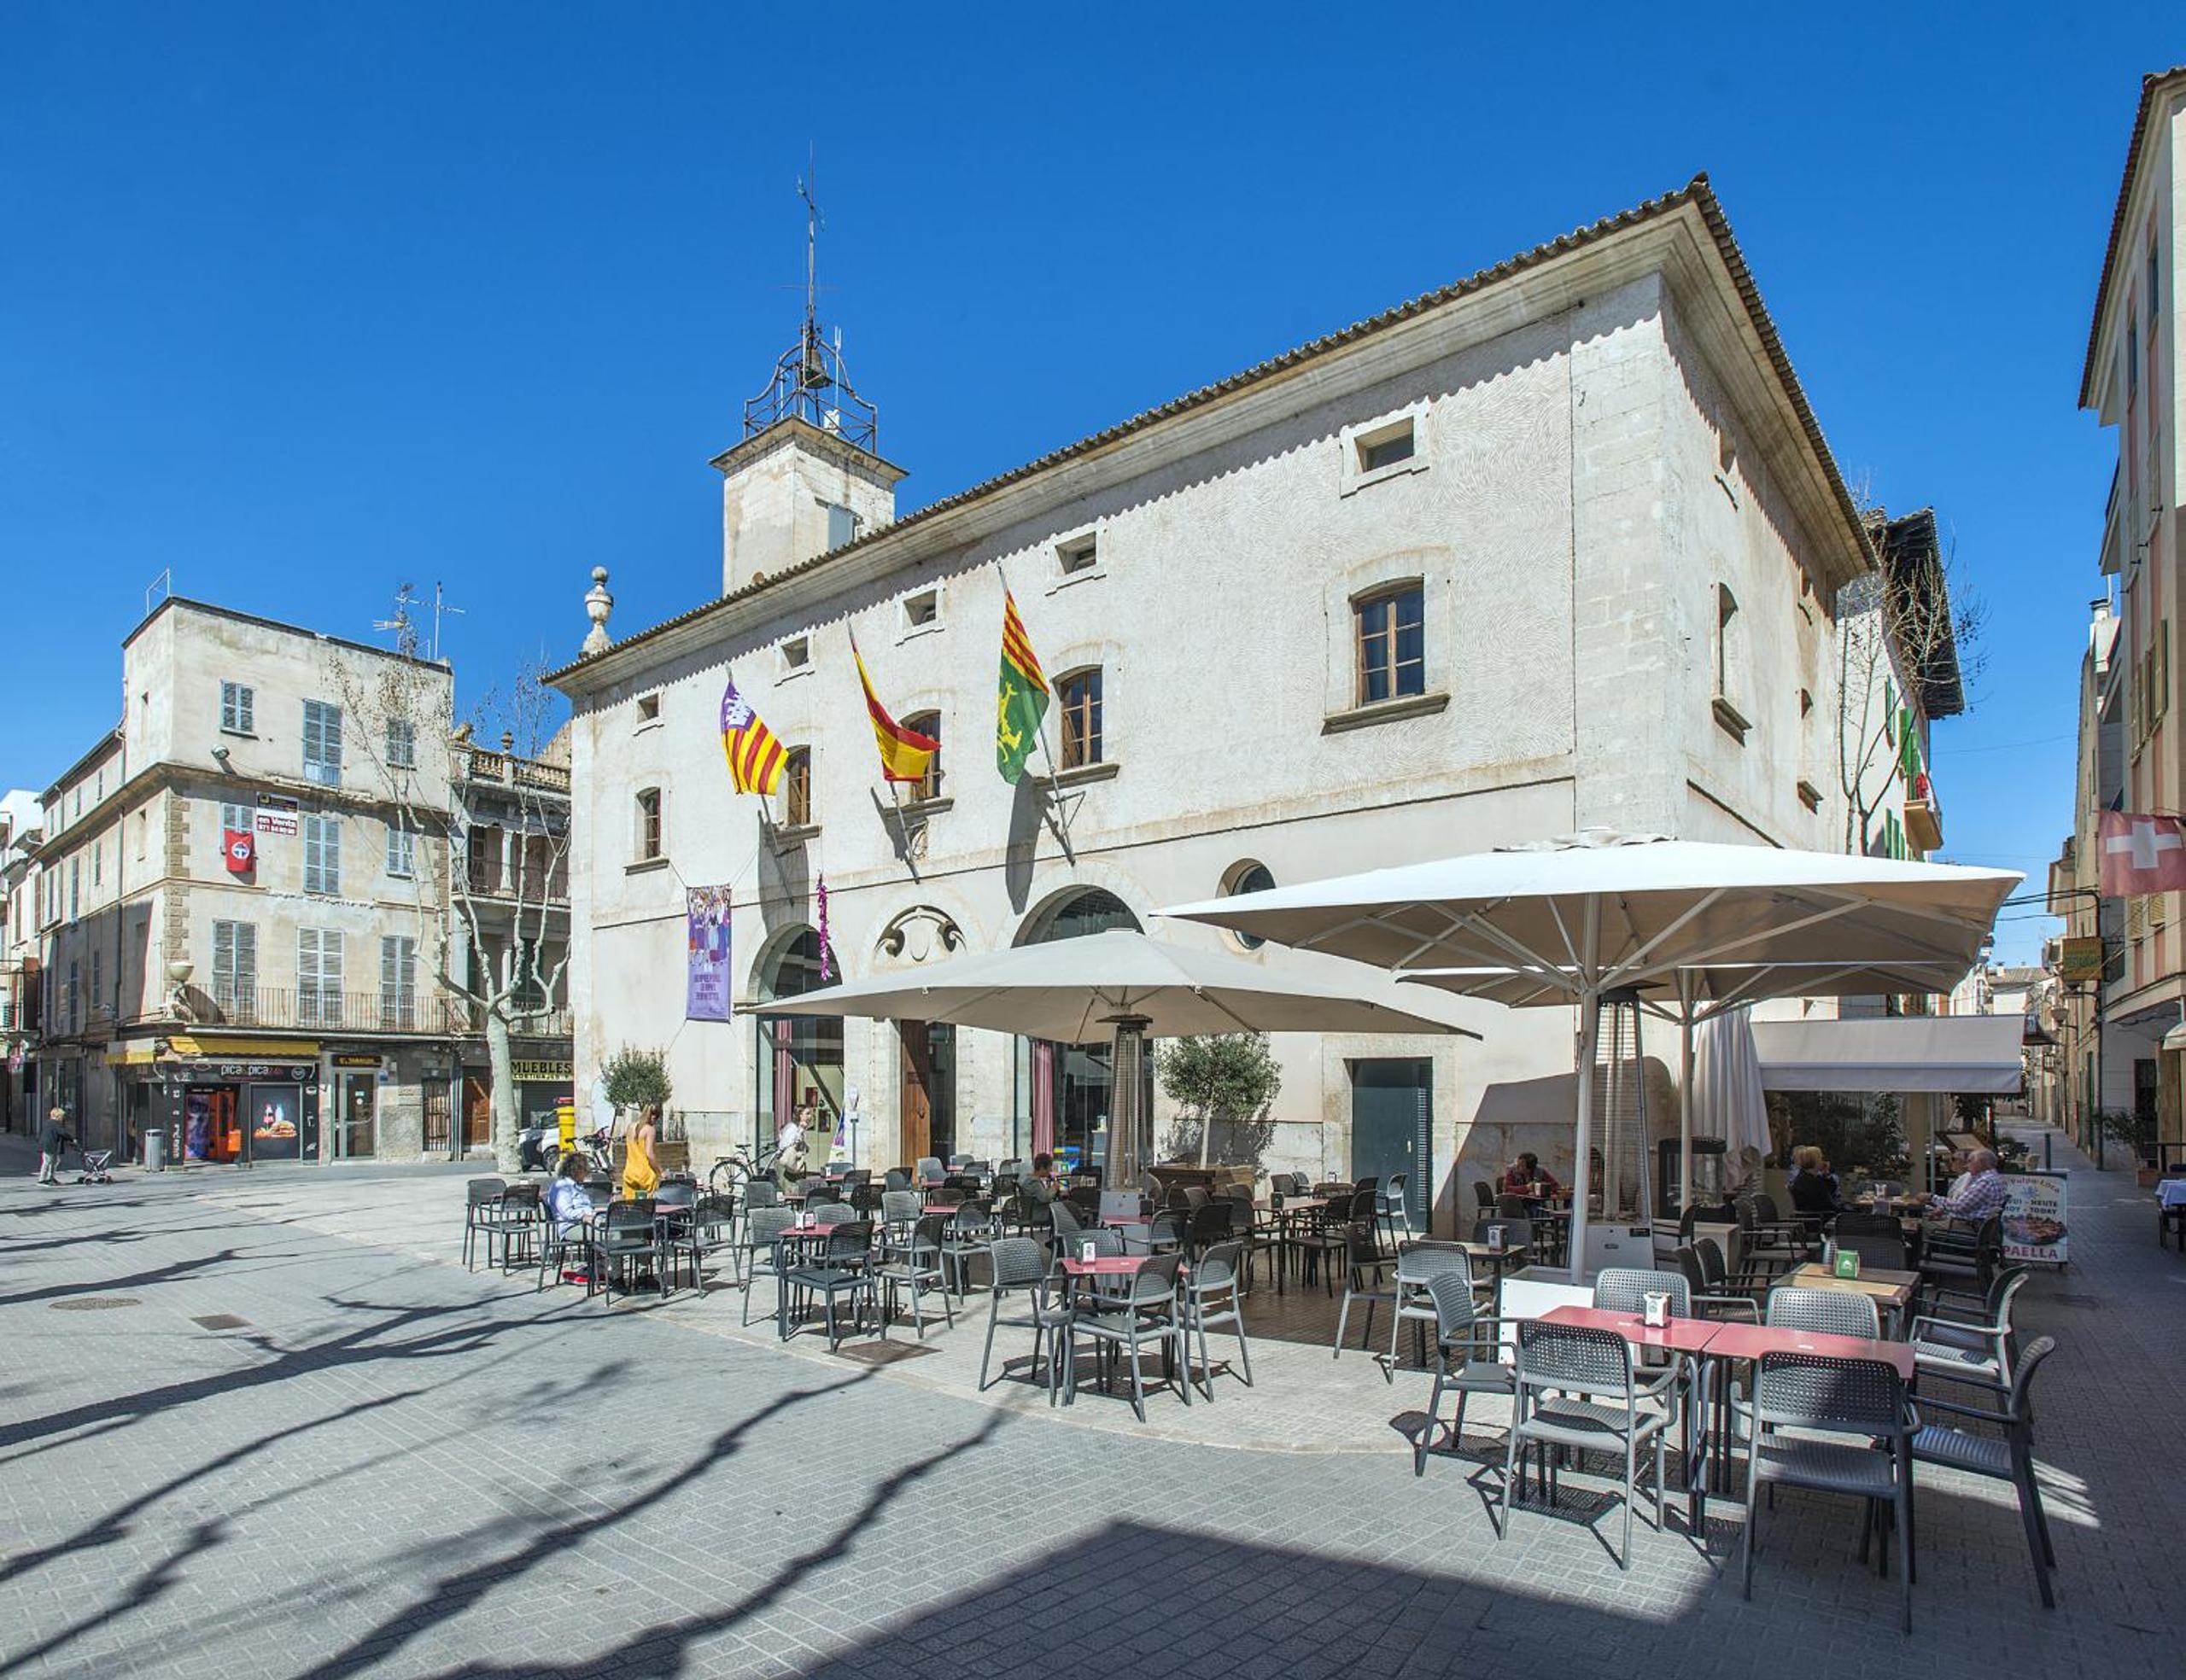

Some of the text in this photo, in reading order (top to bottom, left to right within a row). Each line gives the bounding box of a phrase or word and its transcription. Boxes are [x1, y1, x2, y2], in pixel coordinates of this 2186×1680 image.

[221, 1065, 242, 1076] pica
[248, 1065, 268, 1076] pica
[511, 1061, 572, 1073] MUEBLES
[2031, 1199, 2057, 1207] HEUTE
[2030, 1206, 2057, 1215] TODAY
[2002, 1245, 2059, 1260] PAELLA
